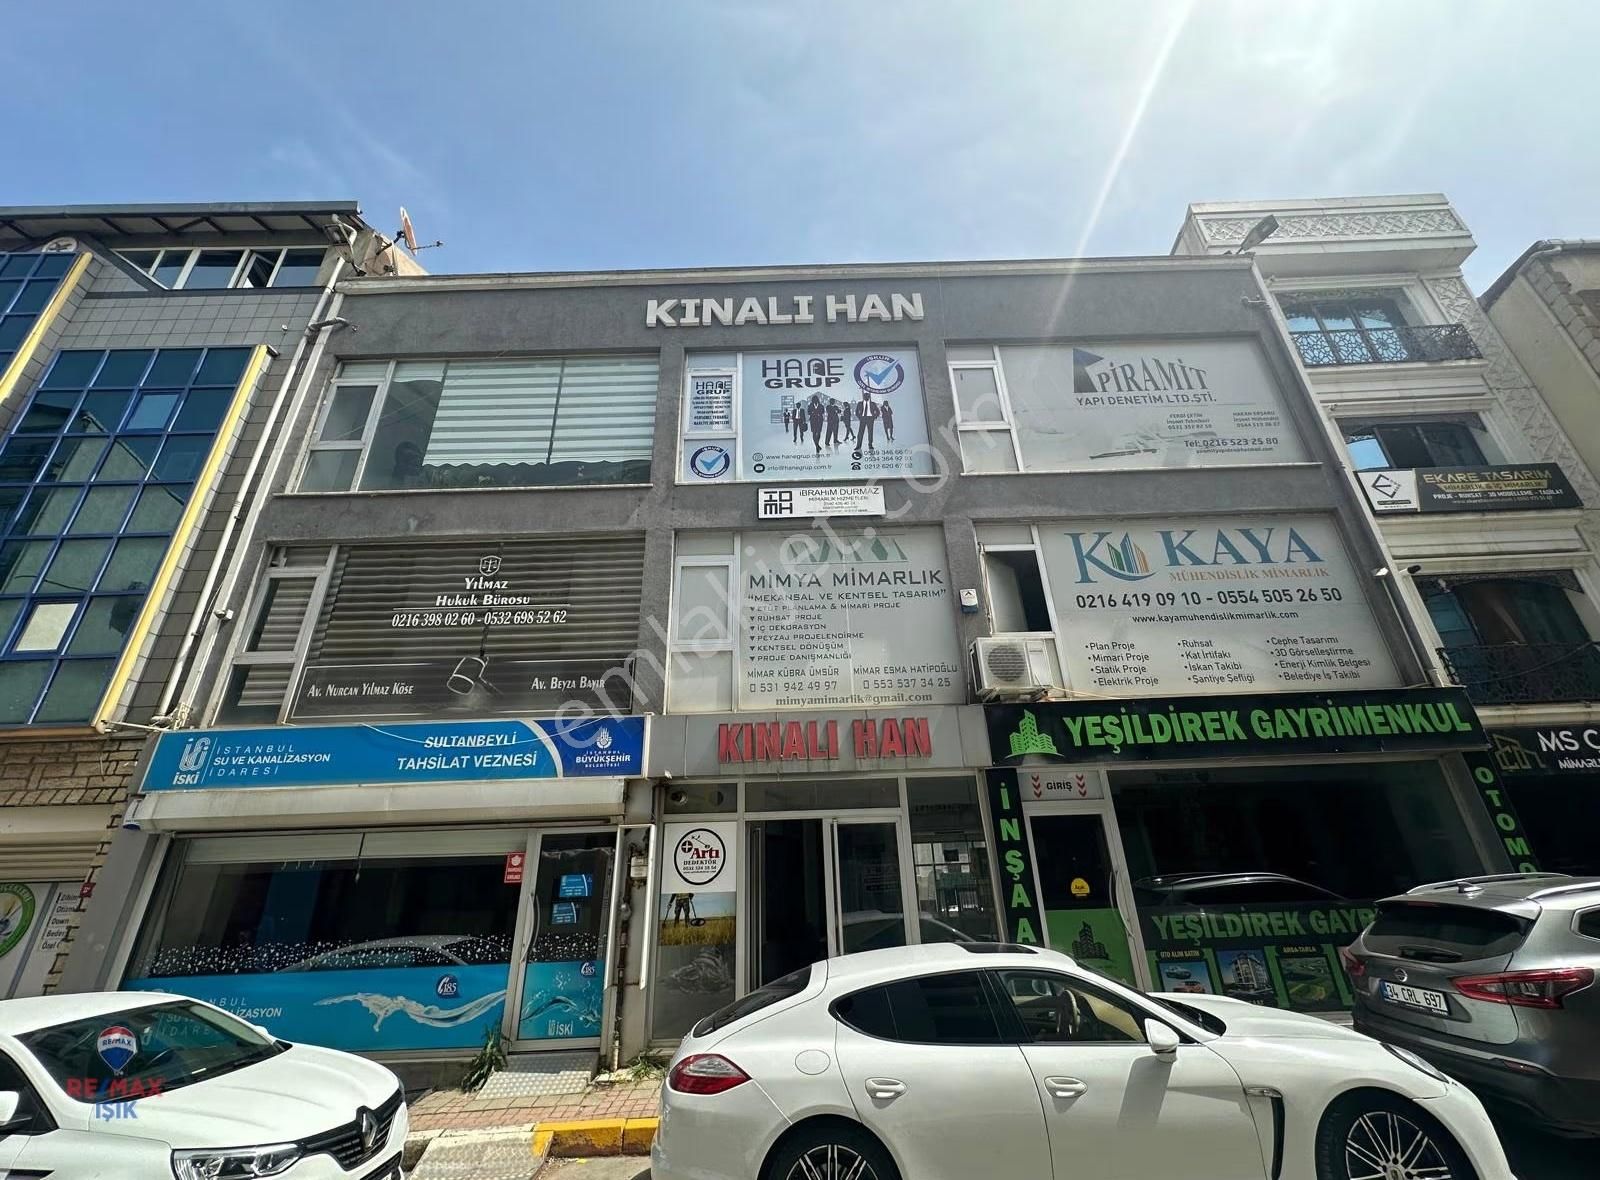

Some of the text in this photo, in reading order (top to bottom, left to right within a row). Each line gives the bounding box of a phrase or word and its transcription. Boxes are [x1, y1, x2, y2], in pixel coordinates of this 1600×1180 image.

[646, 292, 925, 328] KINALI HAN
[1097, 358, 1208, 393] PİRAMİT
[765, 377, 841, 390] GRUP
[1076, 397, 1105, 406] YAPI
[1108, 393, 1164, 405] DENETİM
[1202, 439, 1227, 447] 0216
[1230, 438, 1249, 446] 523
[1266, 437, 1279, 445] 80
[1423, 472, 1478, 483] EKARE
[839, 487, 880, 496] DURMAZ
[1155, 527, 1325, 567] KAYA
[833, 567, 943, 587] MİMARLIK
[1168, 565, 1331, 583] MÜHENDİSLİK MİMARLIK
[819, 592, 833, 600] VE
[838, 591, 888, 600] KENTSEL
[1076, 587, 1342, 609] 0216 419 09 10 0554 505 26 50
[391, 610, 567, 627] 0216 398 02 60 0532 698 52 62
[794, 613, 822, 621] PROJE
[1132, 611, 1299, 624] www.kayamuhendislikmimarlik.com
[769, 623, 827, 631] DEKORASYON
[793, 631, 865, 641] PROJELENDİRME
[1271, 637, 1298, 647] Cephe
[800, 642, 844, 652] DÖNÜŞÜM
[1089, 641, 1135, 652] Plan Proje
[1182, 639, 1213, 648] Ruhsat
[1092, 652, 1150, 662] Mimari Proje
[1185, 651, 1200, 660] Kat
[1275, 648, 1287, 657] 3D
[853, 661, 958, 675] MİMAR ESMA HATİPOĞLU
[1095, 664, 1147, 675] Statik Proje
[1214, 661, 1242, 671] Takibi
[1279, 658, 1371, 671] Enerji Kimlik Belgesi
[747, 666, 840, 678] MİMAR KÜBRA ÜMSÜR
[1284, 671, 1321, 682] Belediye
[1333, 670, 1361, 680] Takibi
[760, 682, 778, 692] 531
[783, 681, 804, 692] 942
[807, 681, 820, 691] 49
[824, 680, 838, 691] 97
[873, 679, 893, 689] 553
[896, 679, 916, 689] 537
[920, 678, 934, 688] 34
[936, 677, 951, 688] 25
[1098, 676, 1159, 687] Elektrik Proje
[775, 692, 933, 708] mimyamimarlik@gmail.com
[1063, 697, 1473, 754] YEŞİLDİREK GAYRİMENKUL
[424, 731, 517, 748] SULTANBEYLİ
[718, 716, 933, 764] KINALI HAN
[1536, 730, 1580, 751] MS
[213, 753, 331, 766] SU VE KANALİZASYON
[397, 750, 538, 771] TAHSİLAT VEZNESİ
[576, 753, 631, 764] BÜYÜKŞEHİR
[1046, 779, 1073, 792] GİRİŞ
[1152, 907, 1306, 946] YEŞİLDİREK
[444, 982, 457, 992] 185
[1386, 984, 1442, 1009] 34 CRL 697
